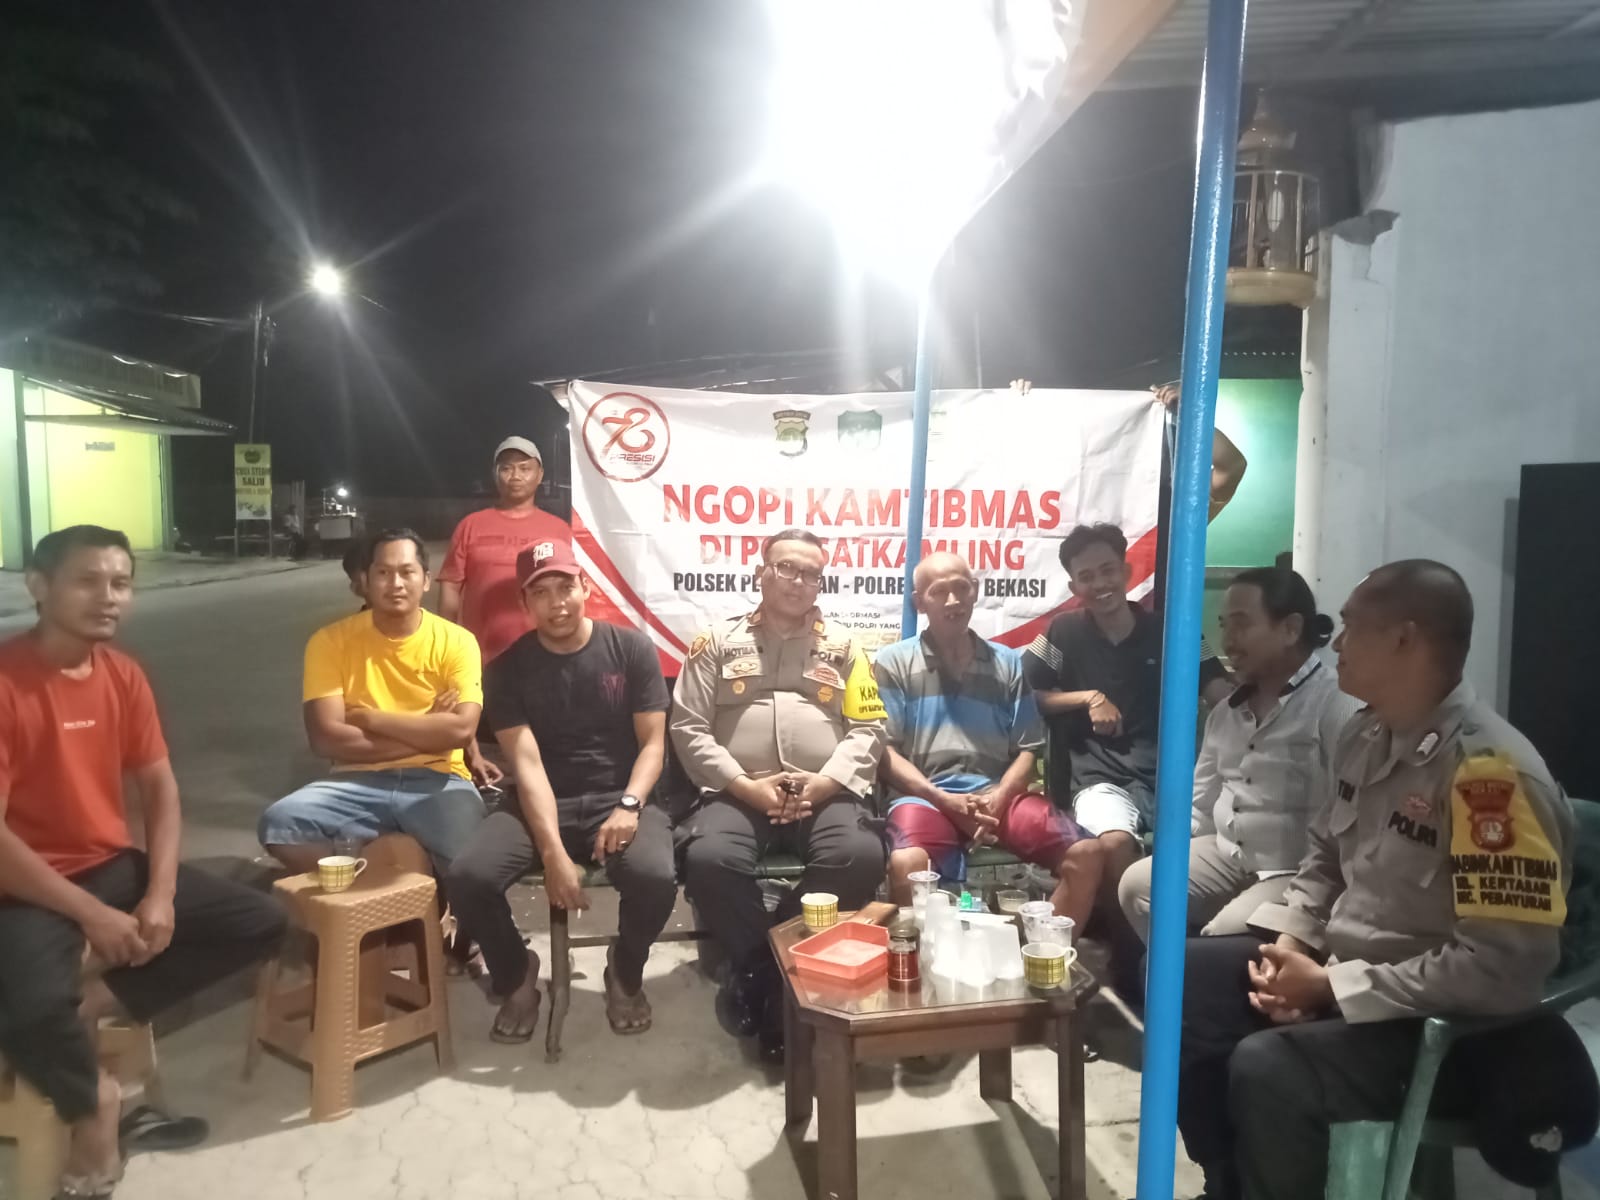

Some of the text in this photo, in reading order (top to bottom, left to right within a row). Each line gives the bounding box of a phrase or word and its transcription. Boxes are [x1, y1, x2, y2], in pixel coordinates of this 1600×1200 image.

[609, 453, 656, 463] RESISI
[663, 484, 1061, 530] NGOPI KAMIBMAS
[700, 535, 731, 565] DI
[673, 572, 736, 593] POLSEK
[984, 578, 1046, 598] BEKASI
[1388, 810, 1437, 848] POLRI
